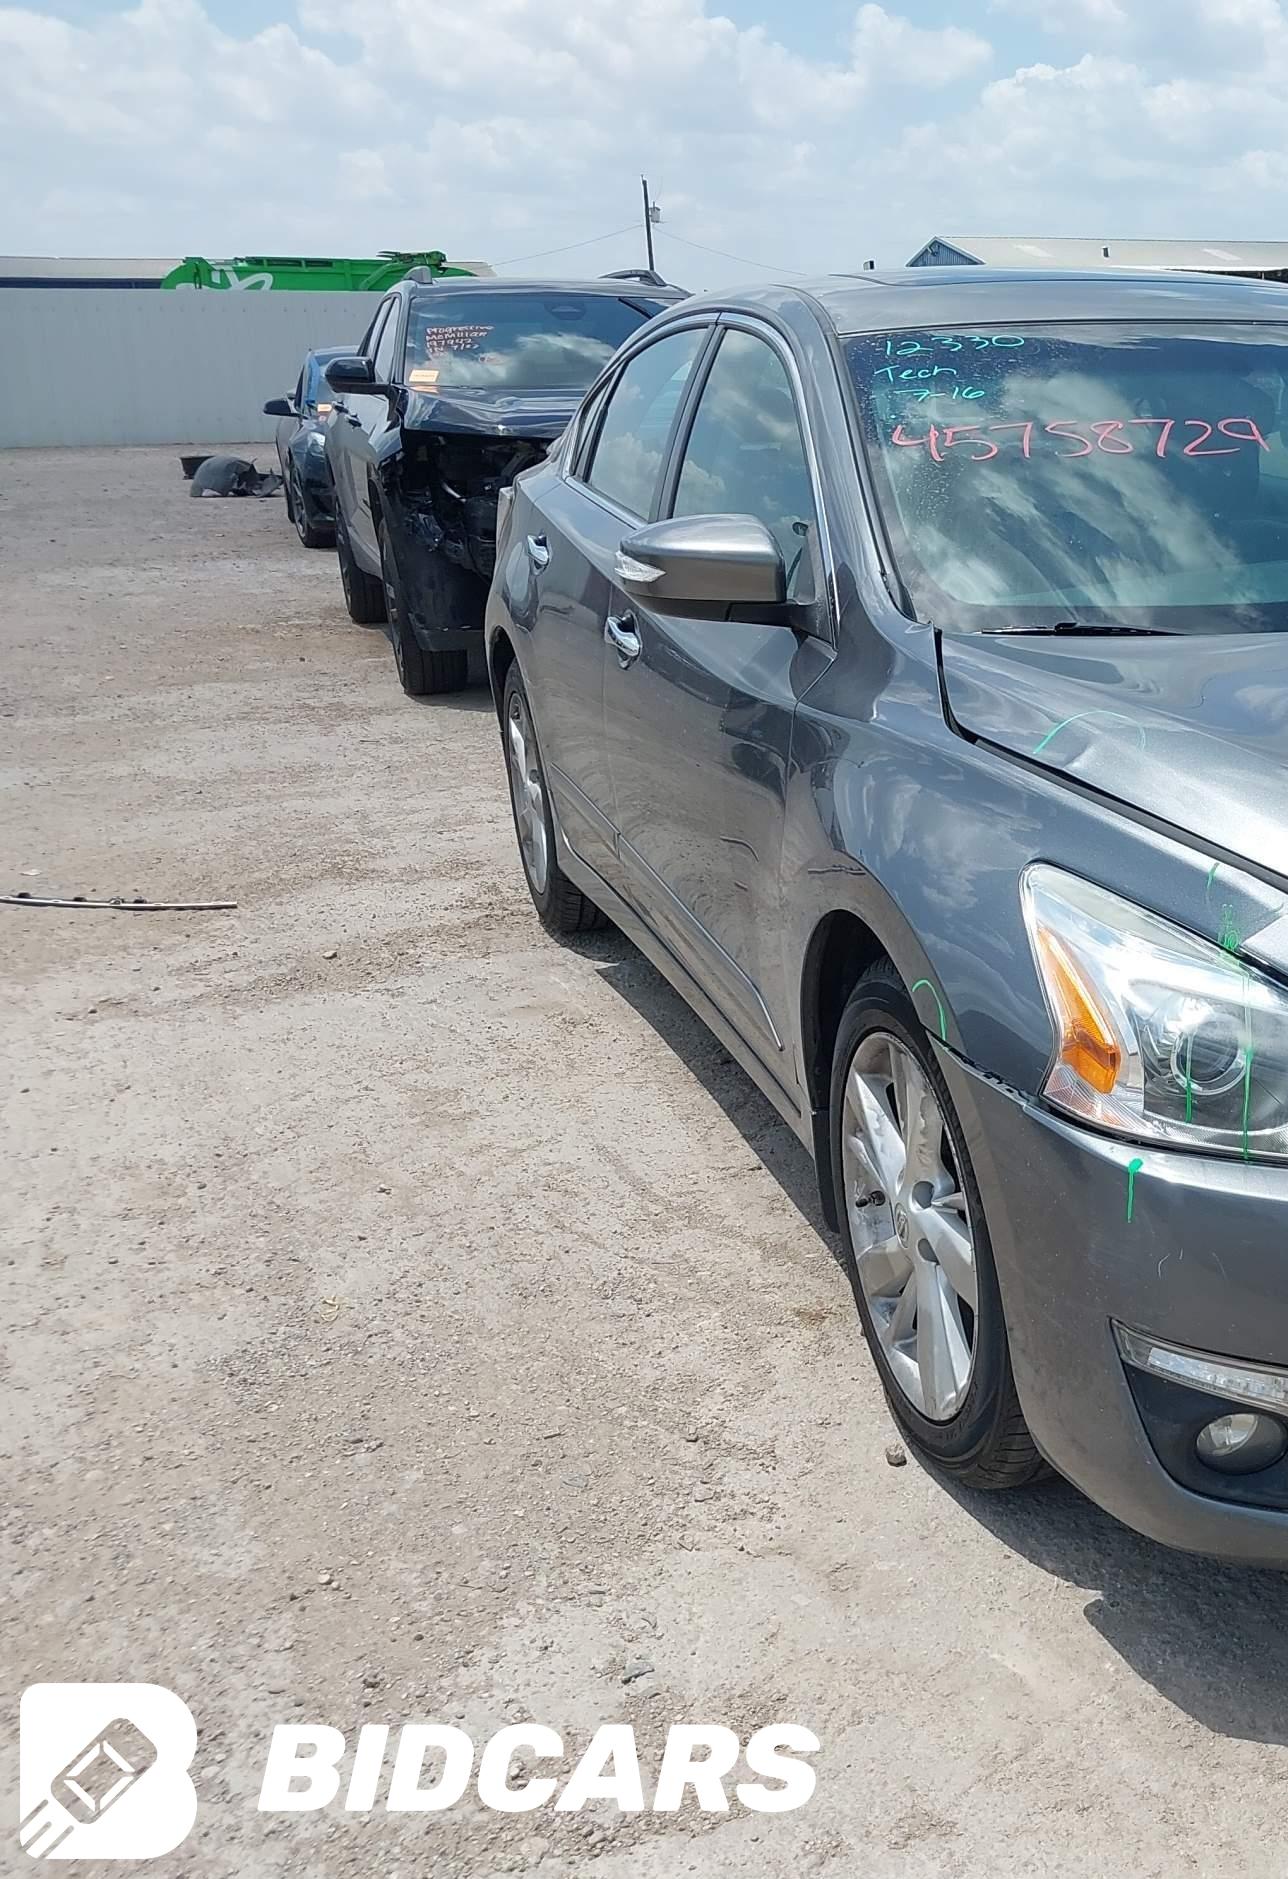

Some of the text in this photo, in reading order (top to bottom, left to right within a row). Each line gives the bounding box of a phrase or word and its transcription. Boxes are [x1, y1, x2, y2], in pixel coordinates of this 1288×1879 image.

[886, 334, 1025, 356] 12330
[874, 364, 957, 383] Tech
[893, 386, 985, 402] 7-16
[891, 417, 1270, 462] 45758729
